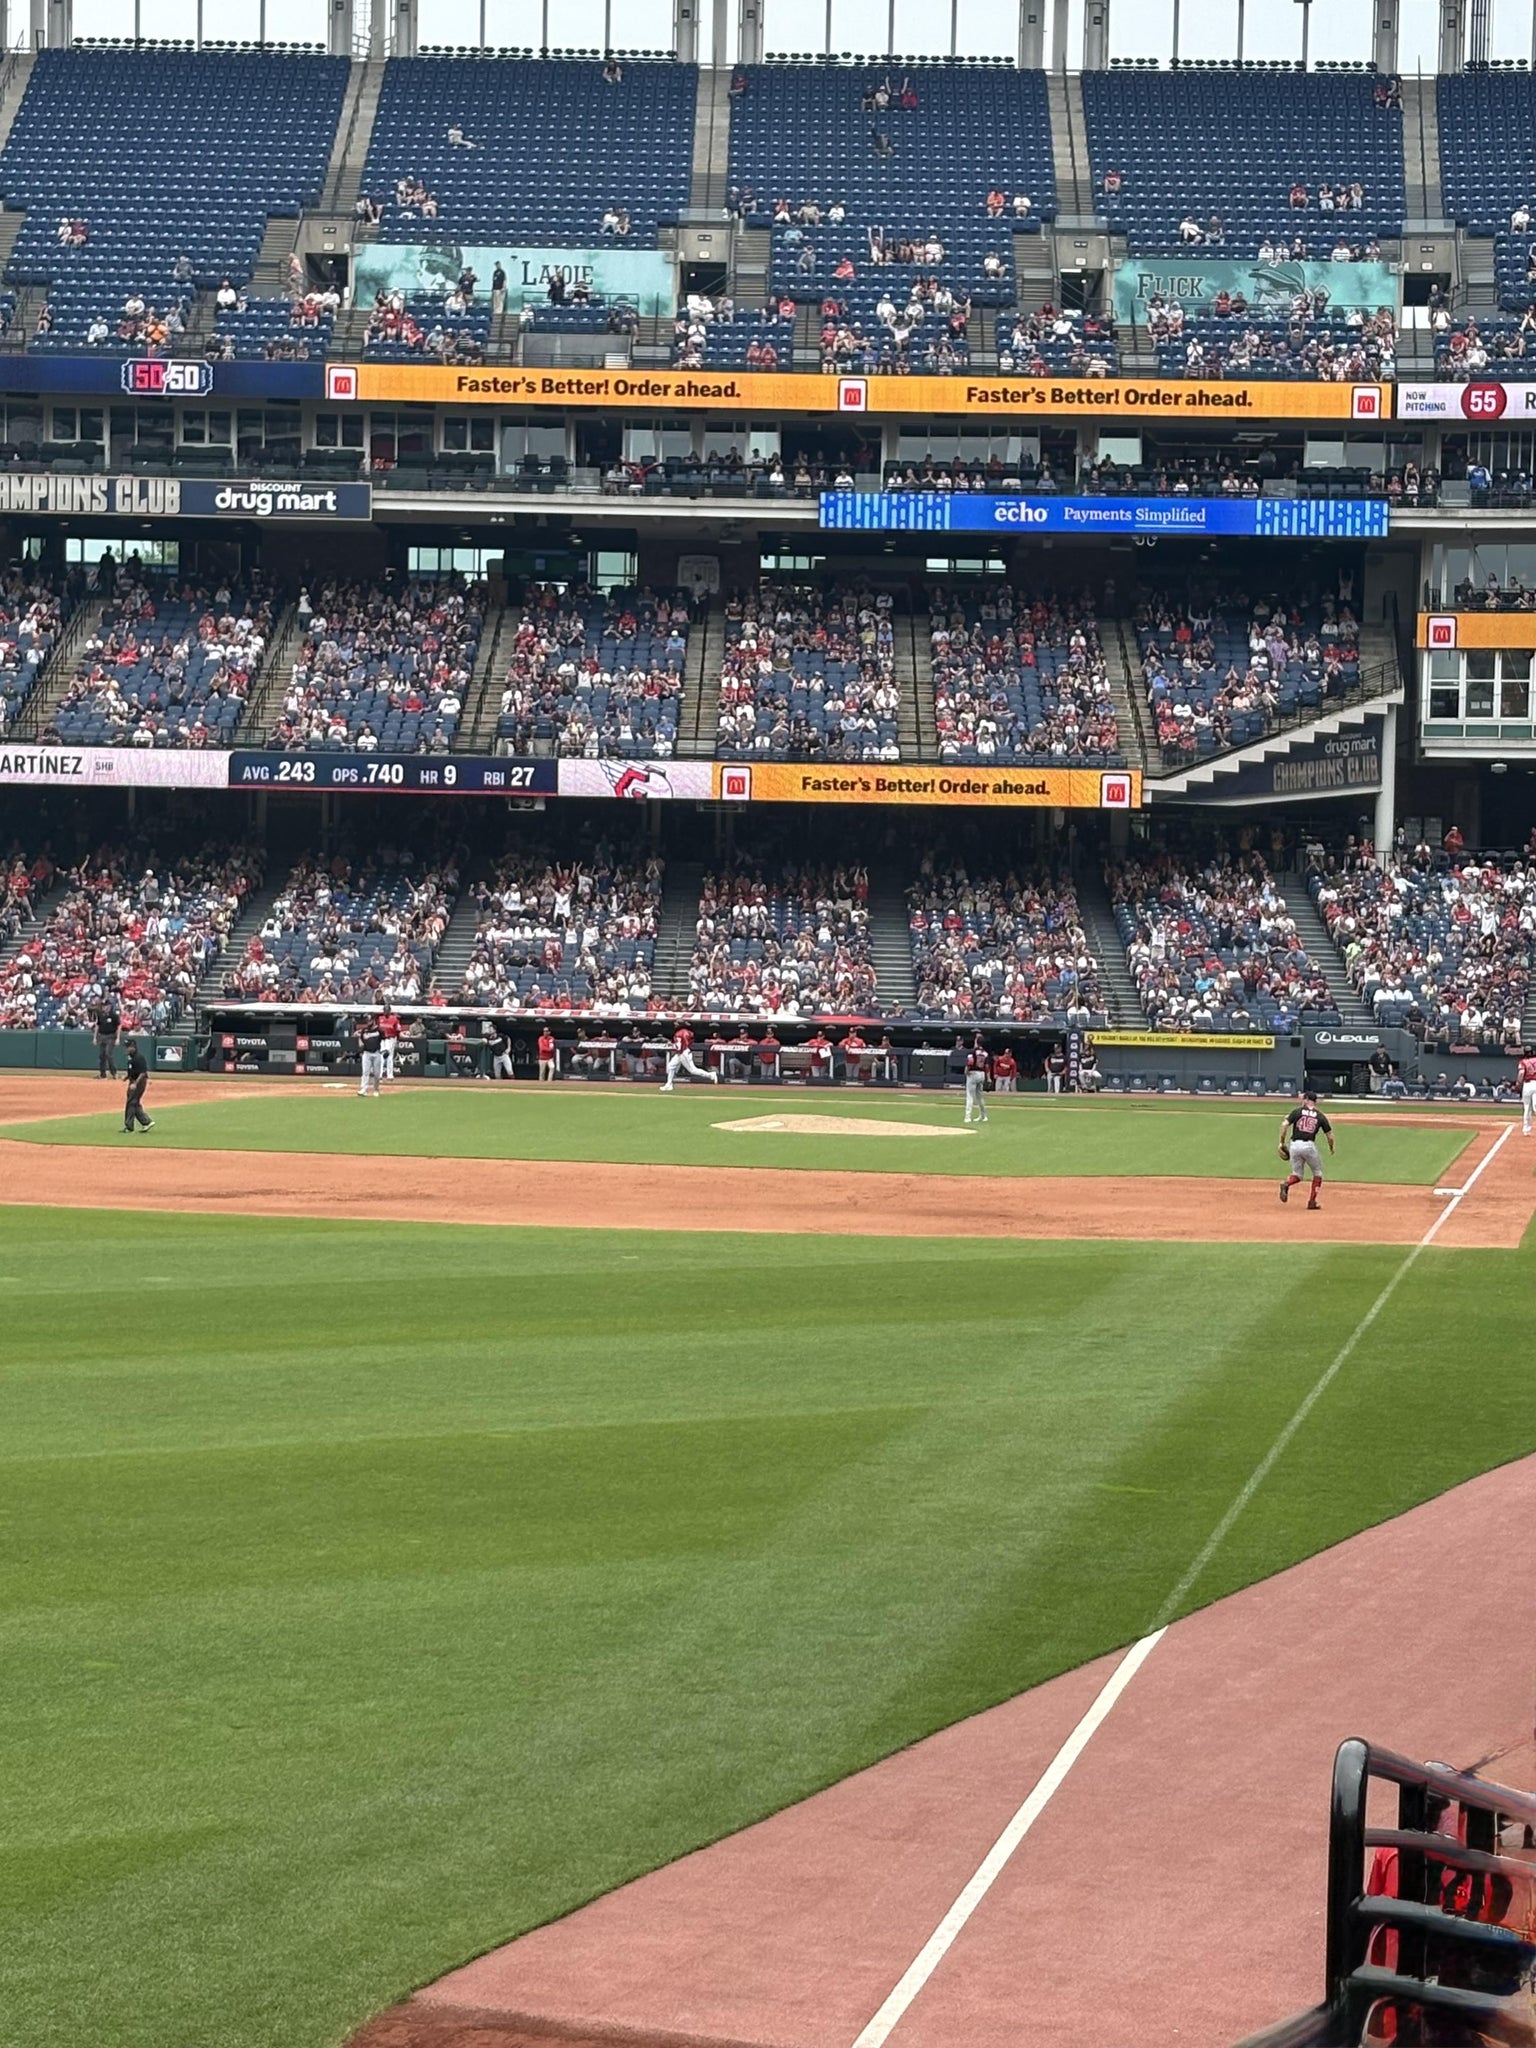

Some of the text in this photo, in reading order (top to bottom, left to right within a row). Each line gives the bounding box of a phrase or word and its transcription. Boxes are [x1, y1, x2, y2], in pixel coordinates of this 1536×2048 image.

[1136, 273, 1204, 298] FLICK
[136, 365, 163, 388] 50
[169, 366, 199, 390] 50
[456, 376, 741, 398] Faster's Better! Order ahead.
[966, 386, 1253, 407] Faster's Better! Order ahead.
[1405, 402, 1446, 411] PITCHING
[1406, 391, 1427, 401] NOW
[1469, 391, 1497, 412] 55
[116, 478, 181, 514] CLUB
[250, 483, 302, 493] DISCOUNT
[215, 487, 337, 516] drug mart
[994, 501, 1206, 525] echo Payments Simplified
[1324, 736, 1377, 757] drug mart
[0, 748, 83, 775] ARTÍNEZ
[242, 761, 535, 787] AVG .243 OPS .740 HR 9 RBI 27
[1273, 754, 1379, 792] CHAMPIONS CLUB
[801, 776, 1051, 795] Faster's Better! Order ahead.
[237, 1038, 266, 1046] TOYOTA
[311, 1040, 341, 1048] TOYOTA
[1333, 1034, 1379, 1043] LEXUS
